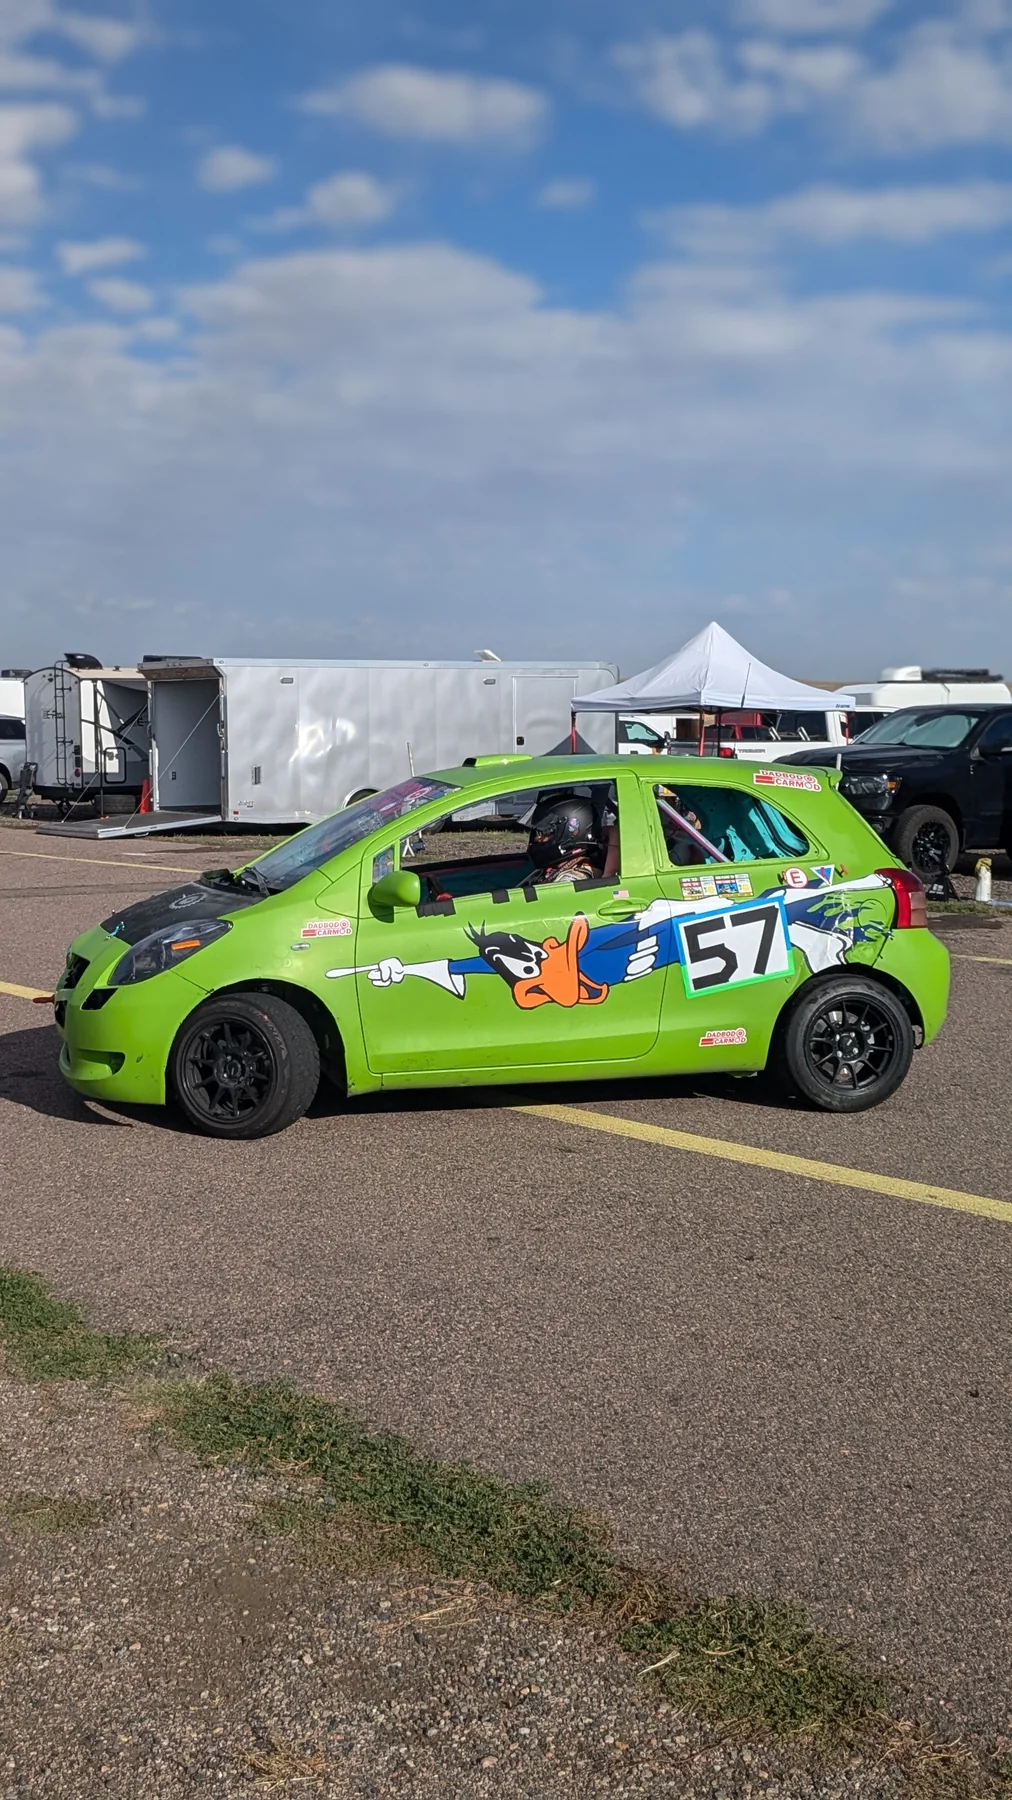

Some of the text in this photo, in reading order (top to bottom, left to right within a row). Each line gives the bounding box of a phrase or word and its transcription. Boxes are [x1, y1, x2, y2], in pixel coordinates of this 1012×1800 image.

[761, 770, 803, 780] DADBOD
[775, 778, 820, 791] CARMOD
[790, 870, 803, 885] E
[308, 921, 339, 929] DADBOD
[683, 905, 779, 991] 57
[714, 1037, 746, 1045] CARMOD
